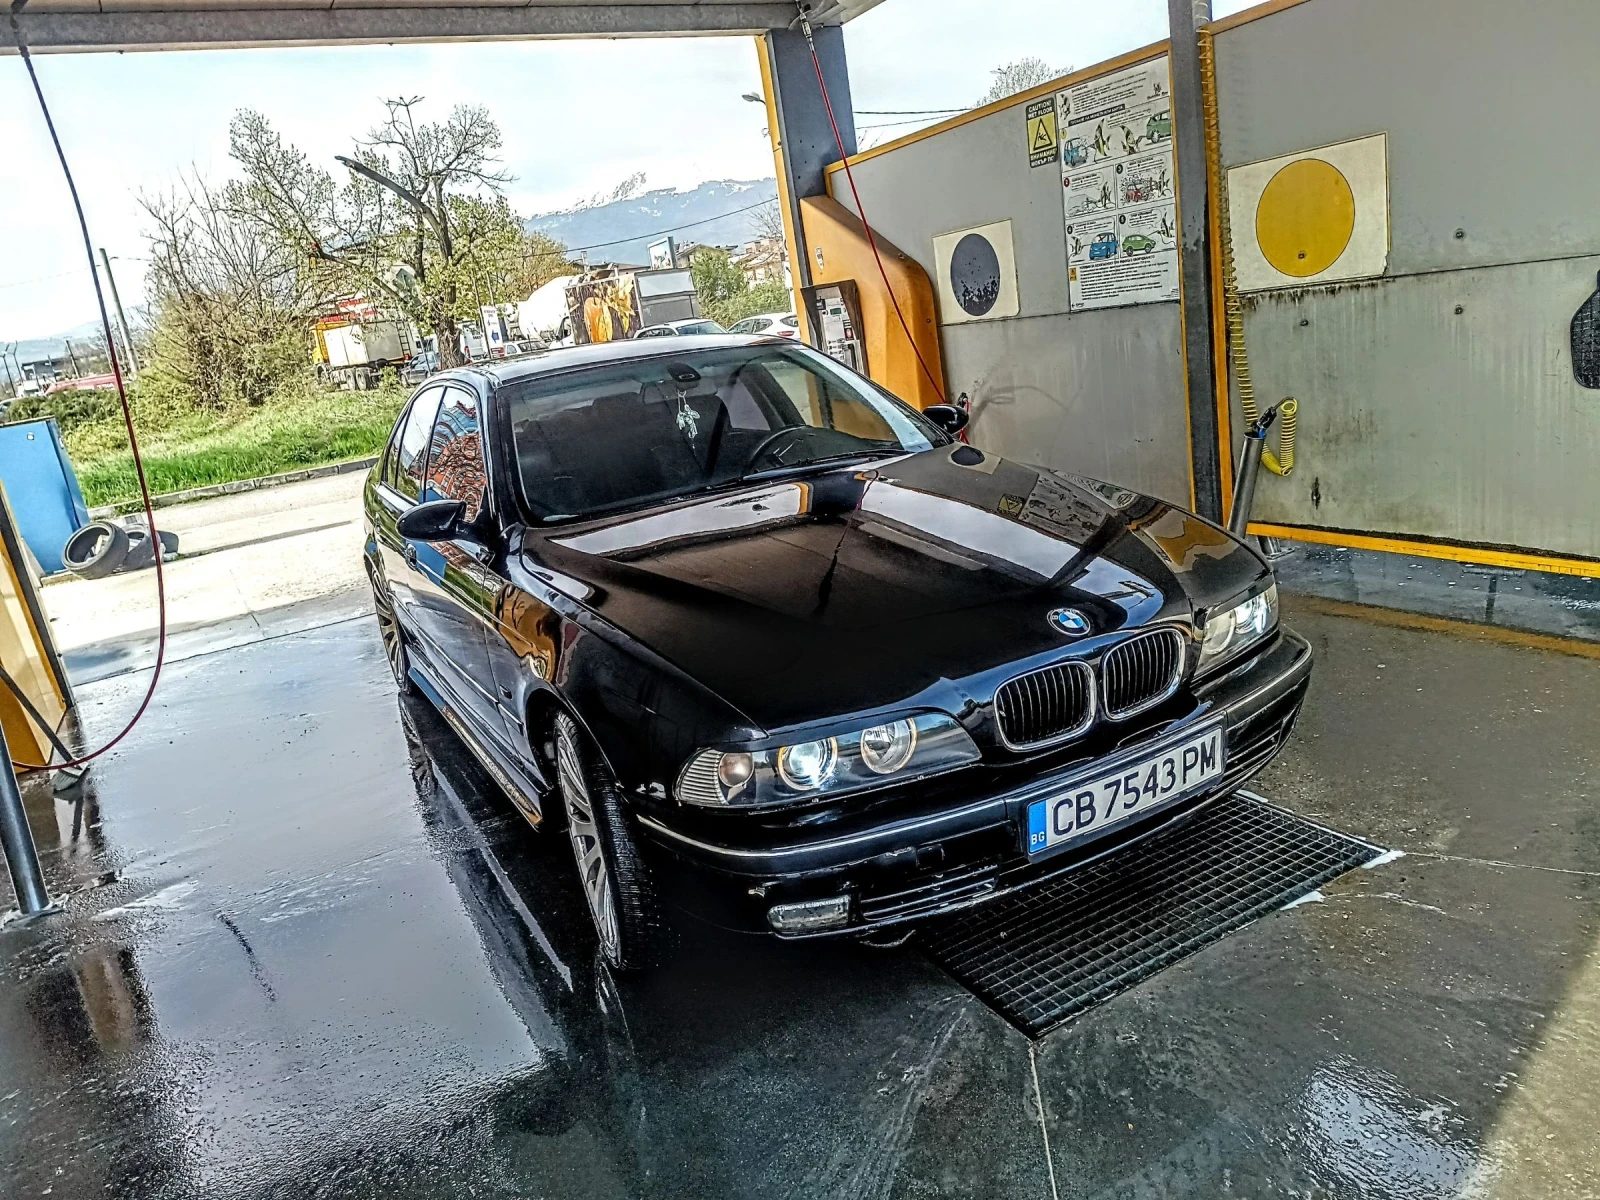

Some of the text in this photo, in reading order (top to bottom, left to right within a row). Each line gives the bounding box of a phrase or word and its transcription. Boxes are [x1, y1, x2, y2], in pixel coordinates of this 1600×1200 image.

[1028, 107, 1053, 119] WET FLOOR
[1052, 735, 1216, 836] CB 7543 PM
[1031, 831, 1045, 845] BG
